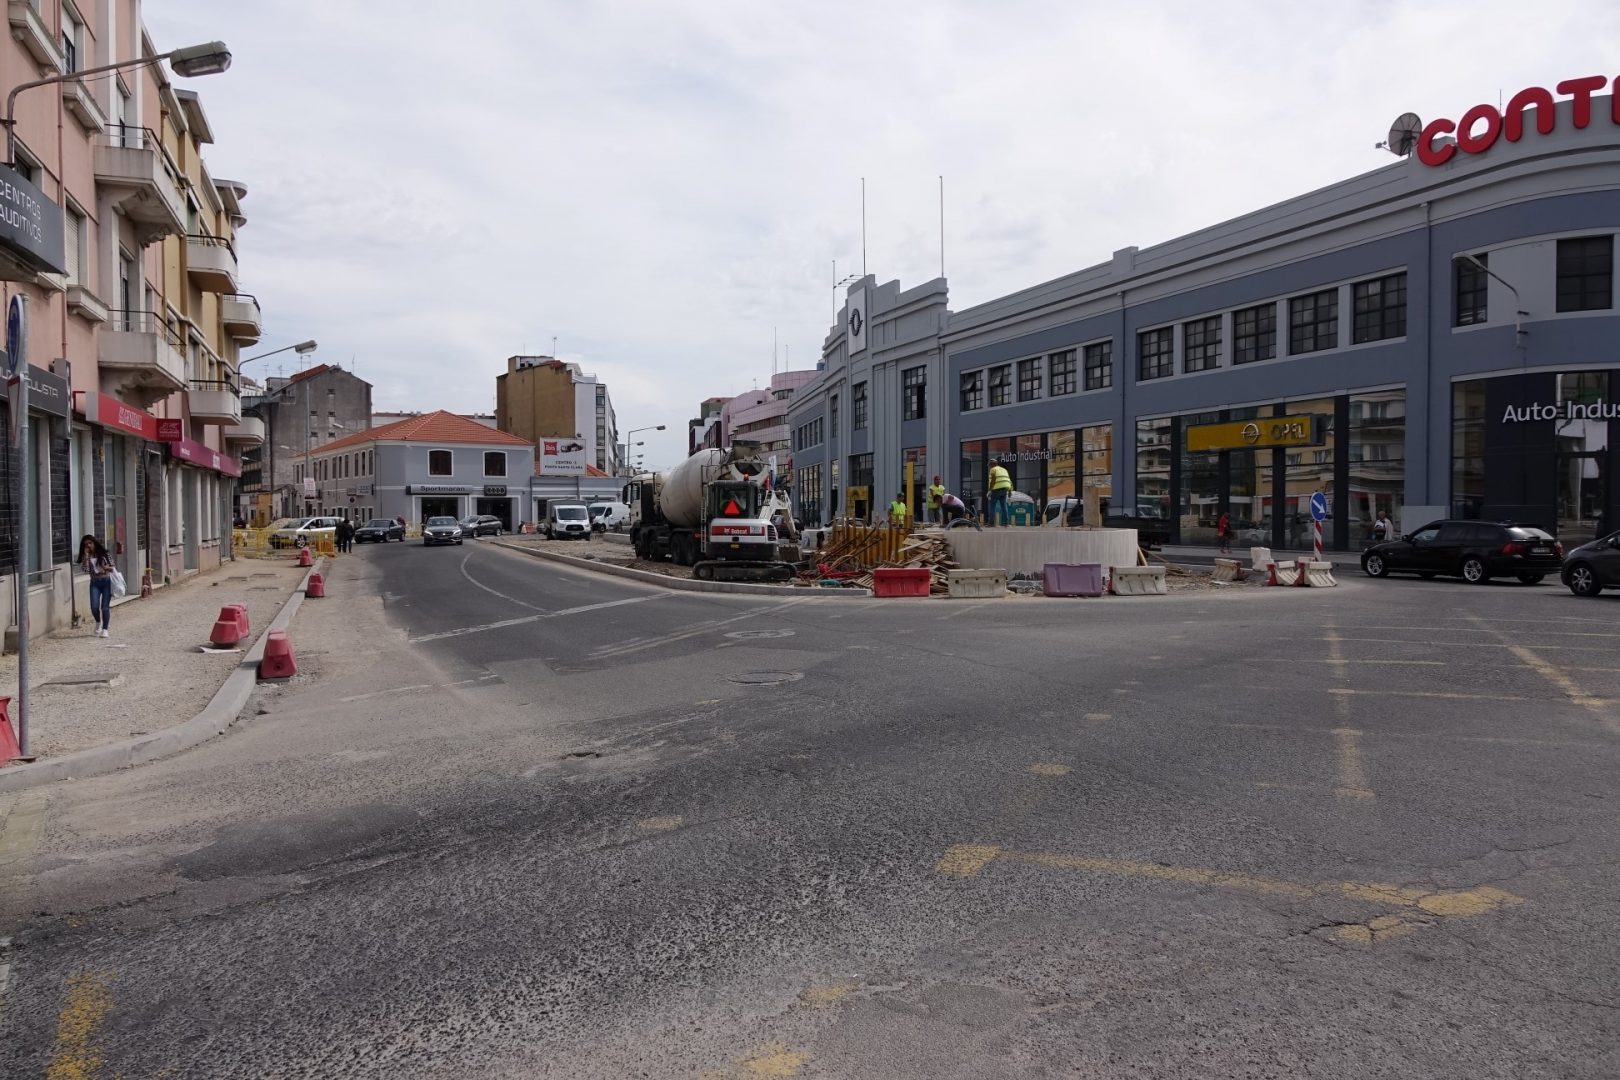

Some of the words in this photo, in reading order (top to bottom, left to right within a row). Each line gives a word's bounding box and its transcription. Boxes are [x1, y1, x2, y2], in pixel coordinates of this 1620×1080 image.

[0, 178, 42, 220] CENTROS
[1502, 402, 1557, 424] Auto
[1567, 397, 1620, 419] Indu
[1000, 452, 1017, 463] Auto
[1017, 449, 1053, 461] Industrial
